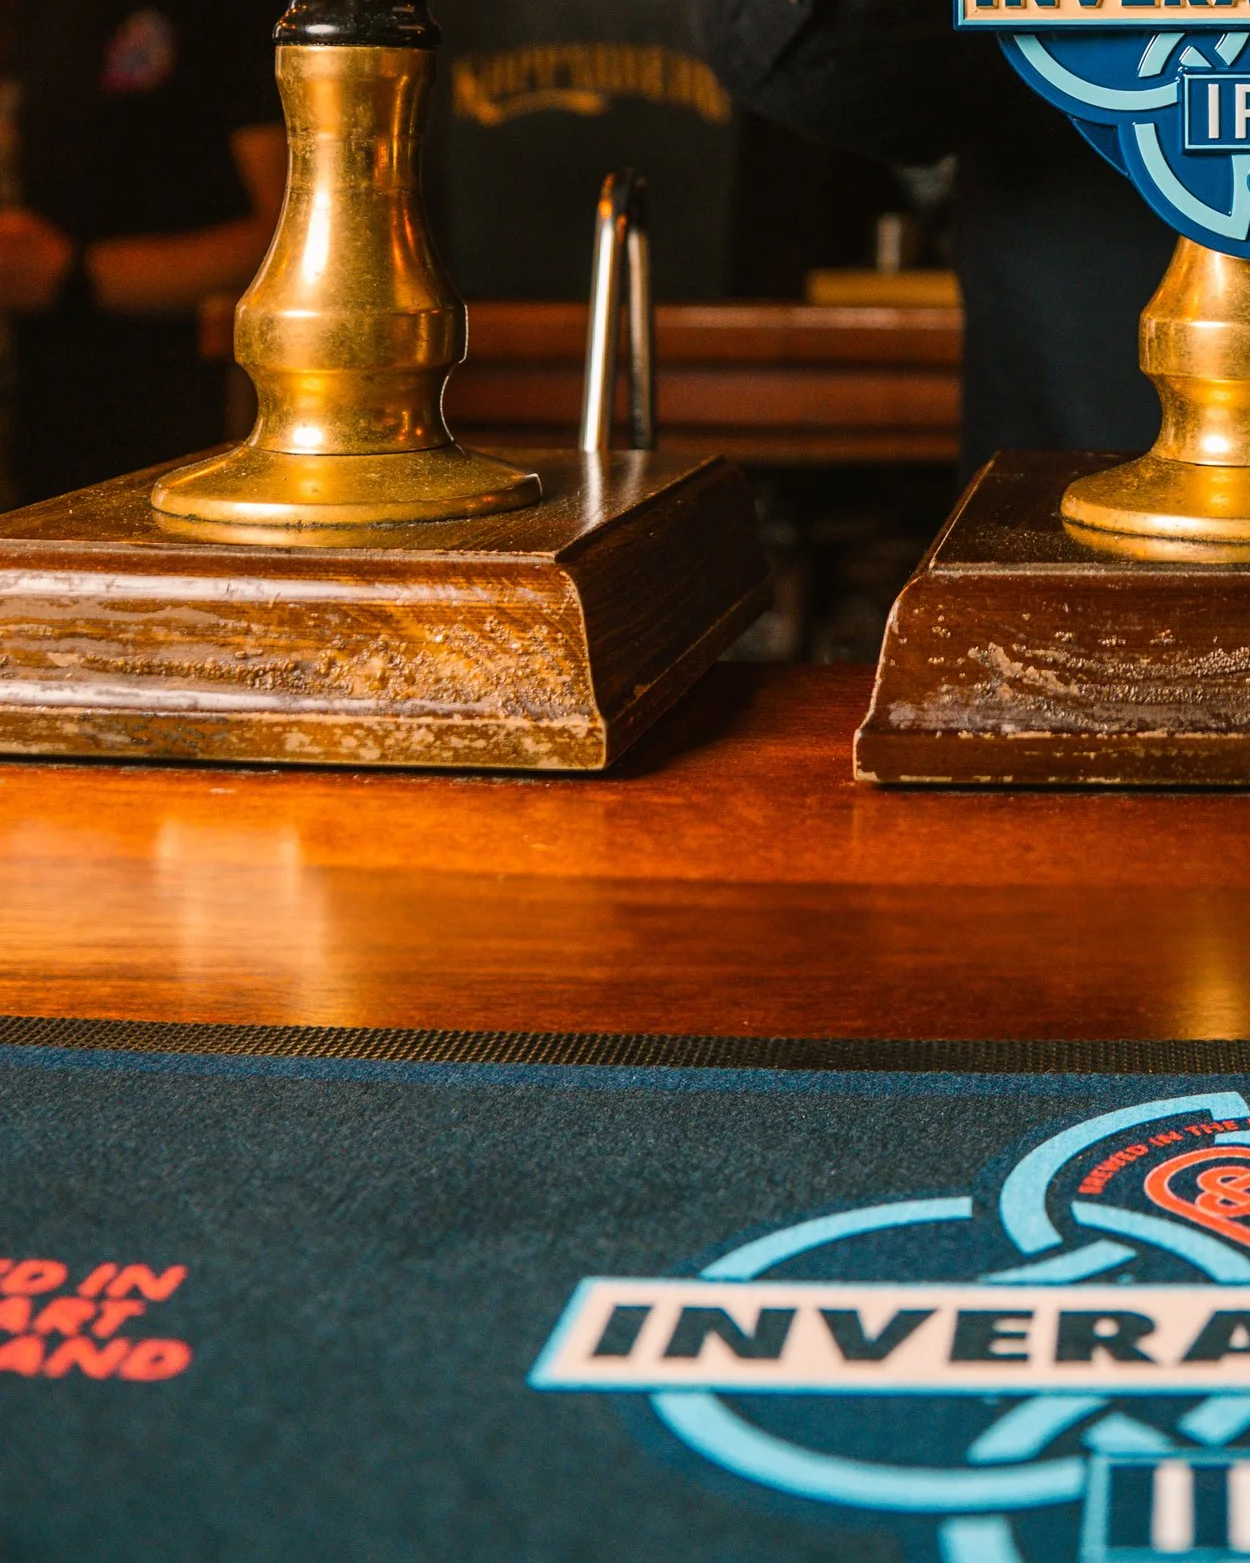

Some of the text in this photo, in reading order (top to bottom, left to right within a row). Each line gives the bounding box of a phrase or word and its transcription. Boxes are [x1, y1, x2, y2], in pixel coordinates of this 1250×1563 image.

[1148, 1130, 1183, 1147] IN
[1184, 1121, 1239, 1136] THE
[77, 1261, 189, 1302] IN
